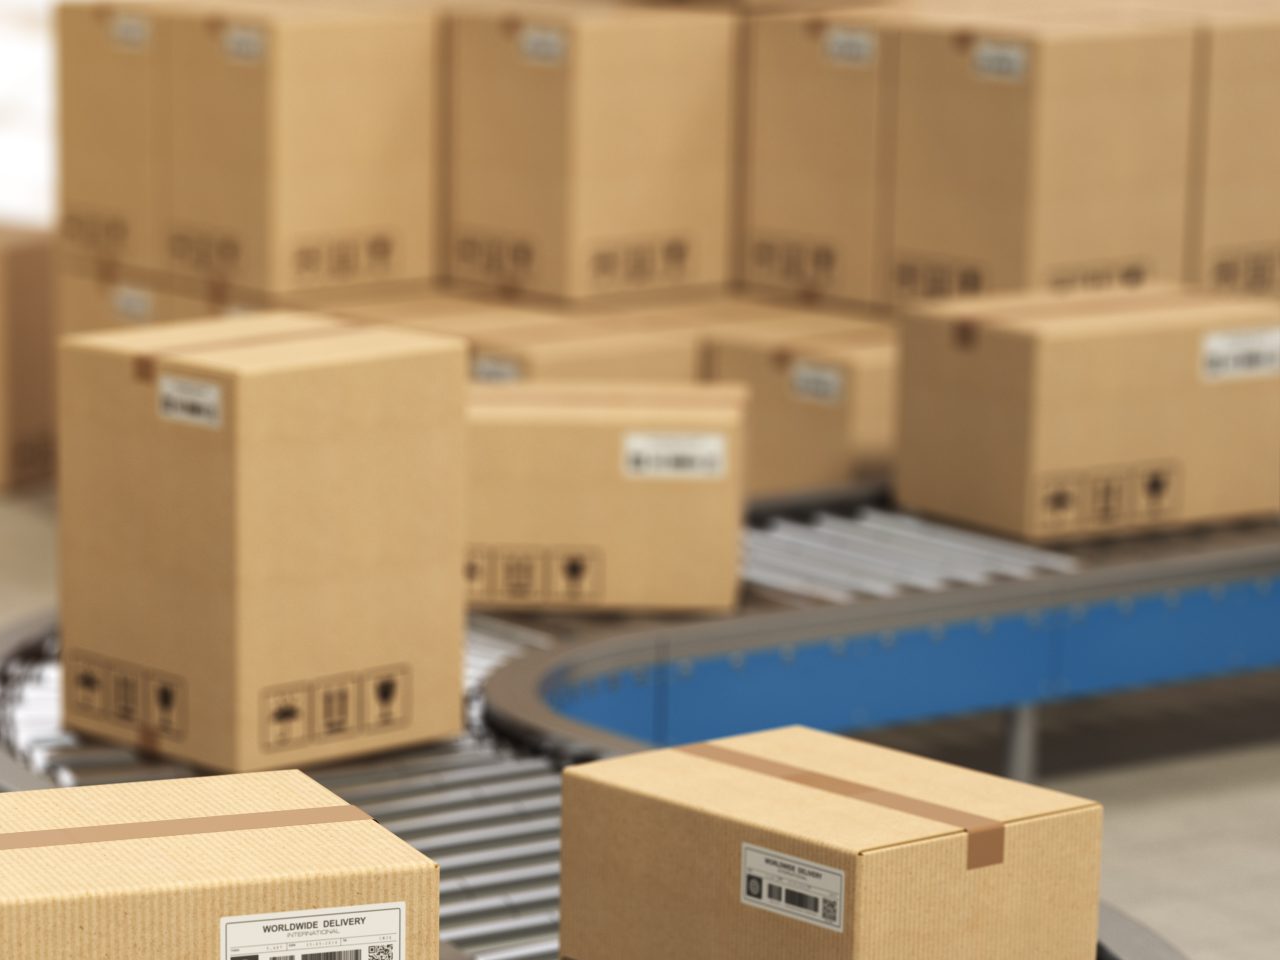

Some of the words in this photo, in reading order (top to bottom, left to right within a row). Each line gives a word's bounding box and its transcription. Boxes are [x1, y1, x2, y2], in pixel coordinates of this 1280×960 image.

[263, 921, 318, 933] WORLDWIDE
[323, 917, 366, 928] DELIVERY
[287, 929, 340, 938] INTERNATIONAL
